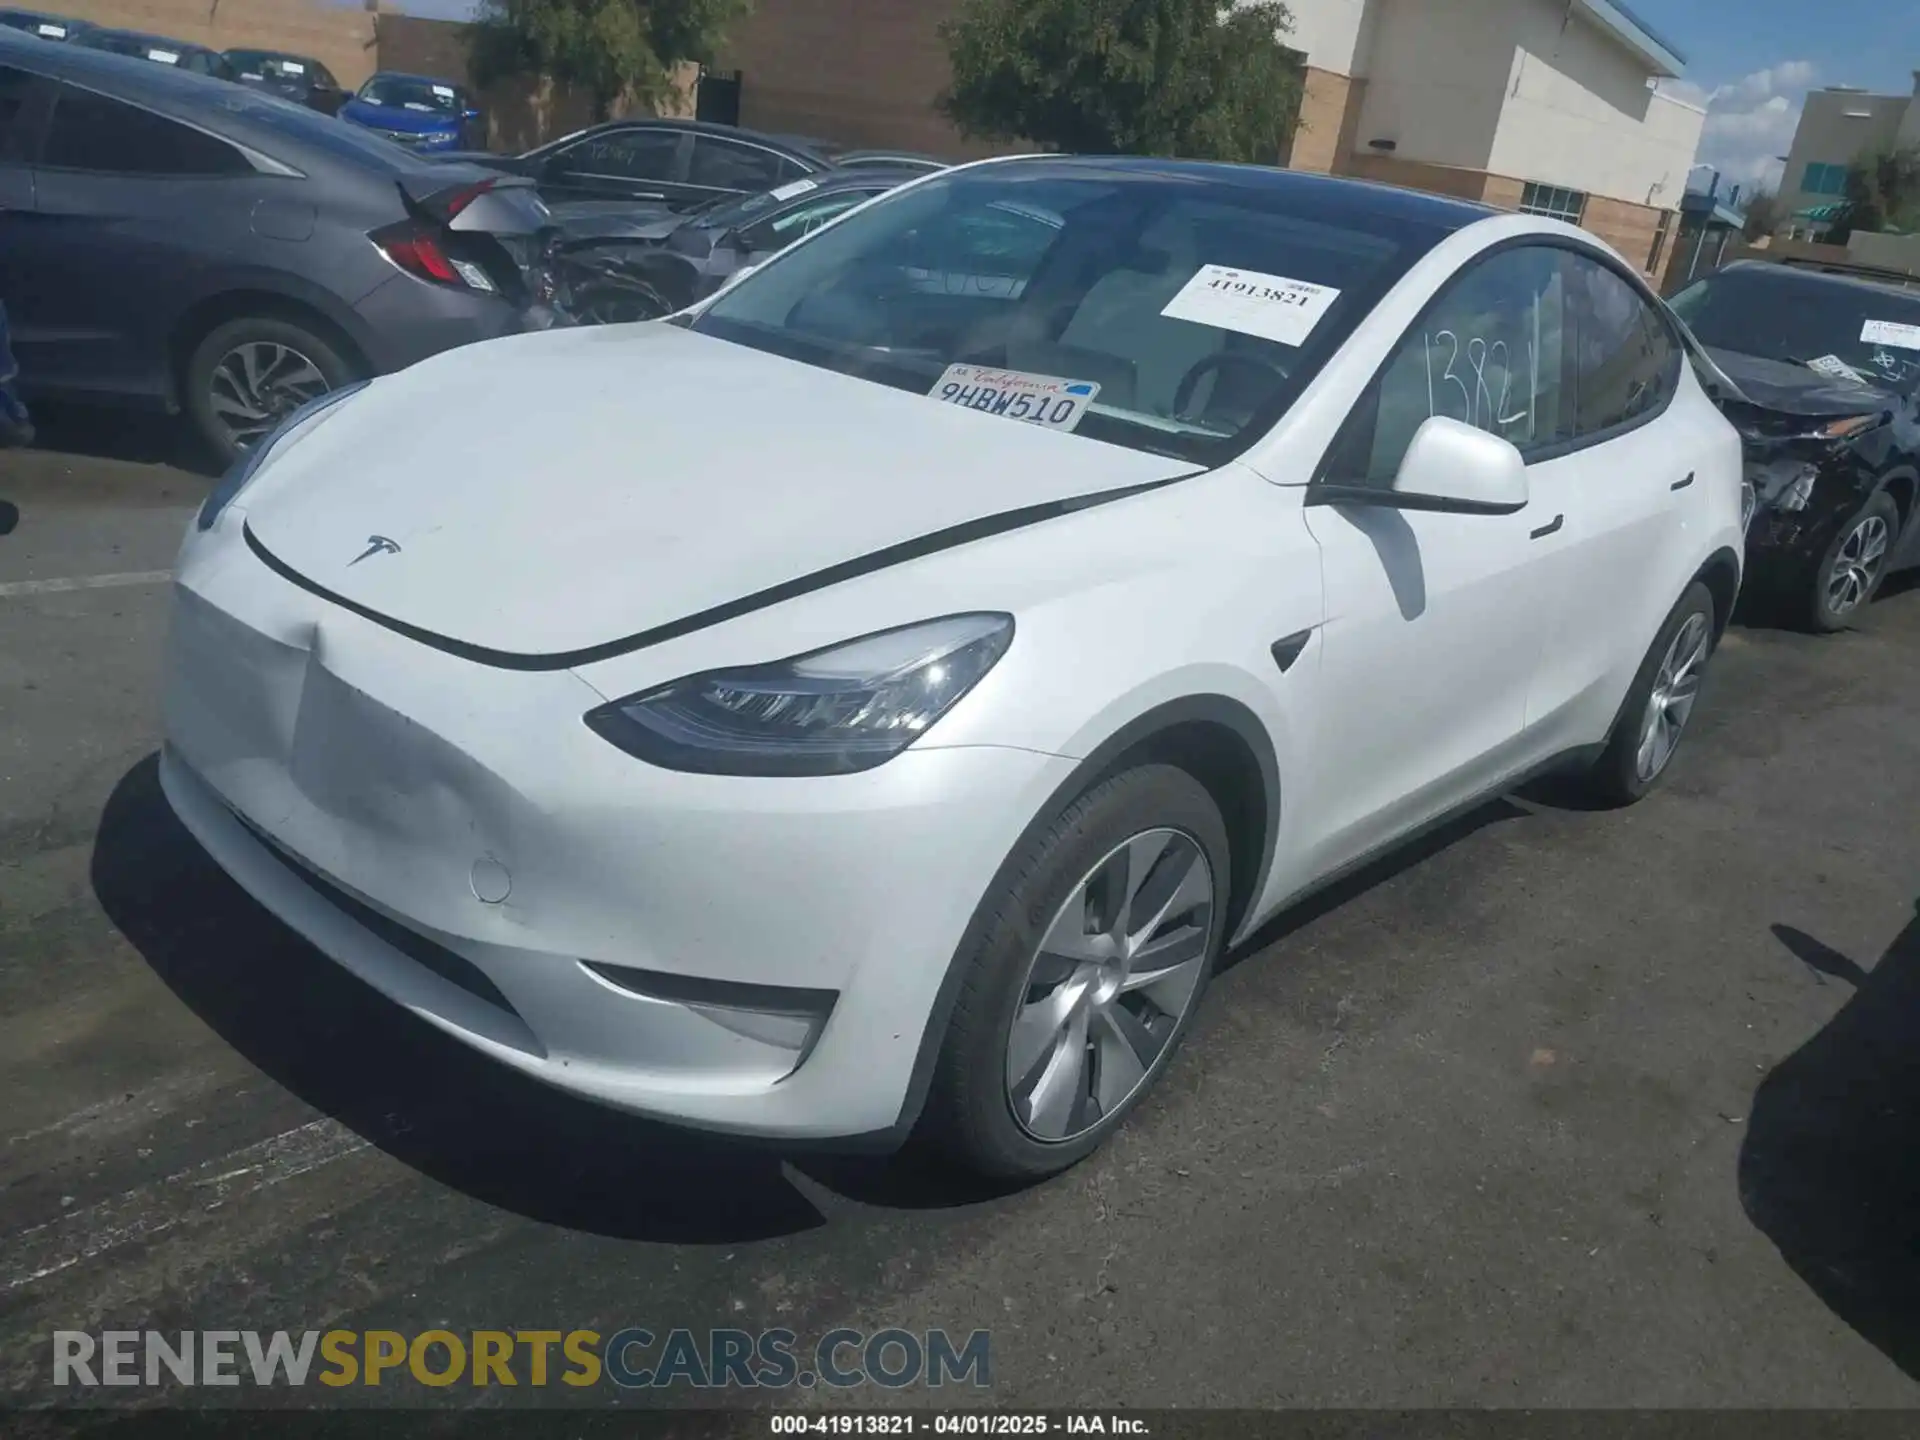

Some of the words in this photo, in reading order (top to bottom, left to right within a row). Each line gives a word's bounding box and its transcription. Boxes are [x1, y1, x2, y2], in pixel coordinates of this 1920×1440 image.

[1208, 279, 1308, 307] 41913821
[973, 369, 1059, 393] California
[941, 383, 1075, 423] 9HBW510
